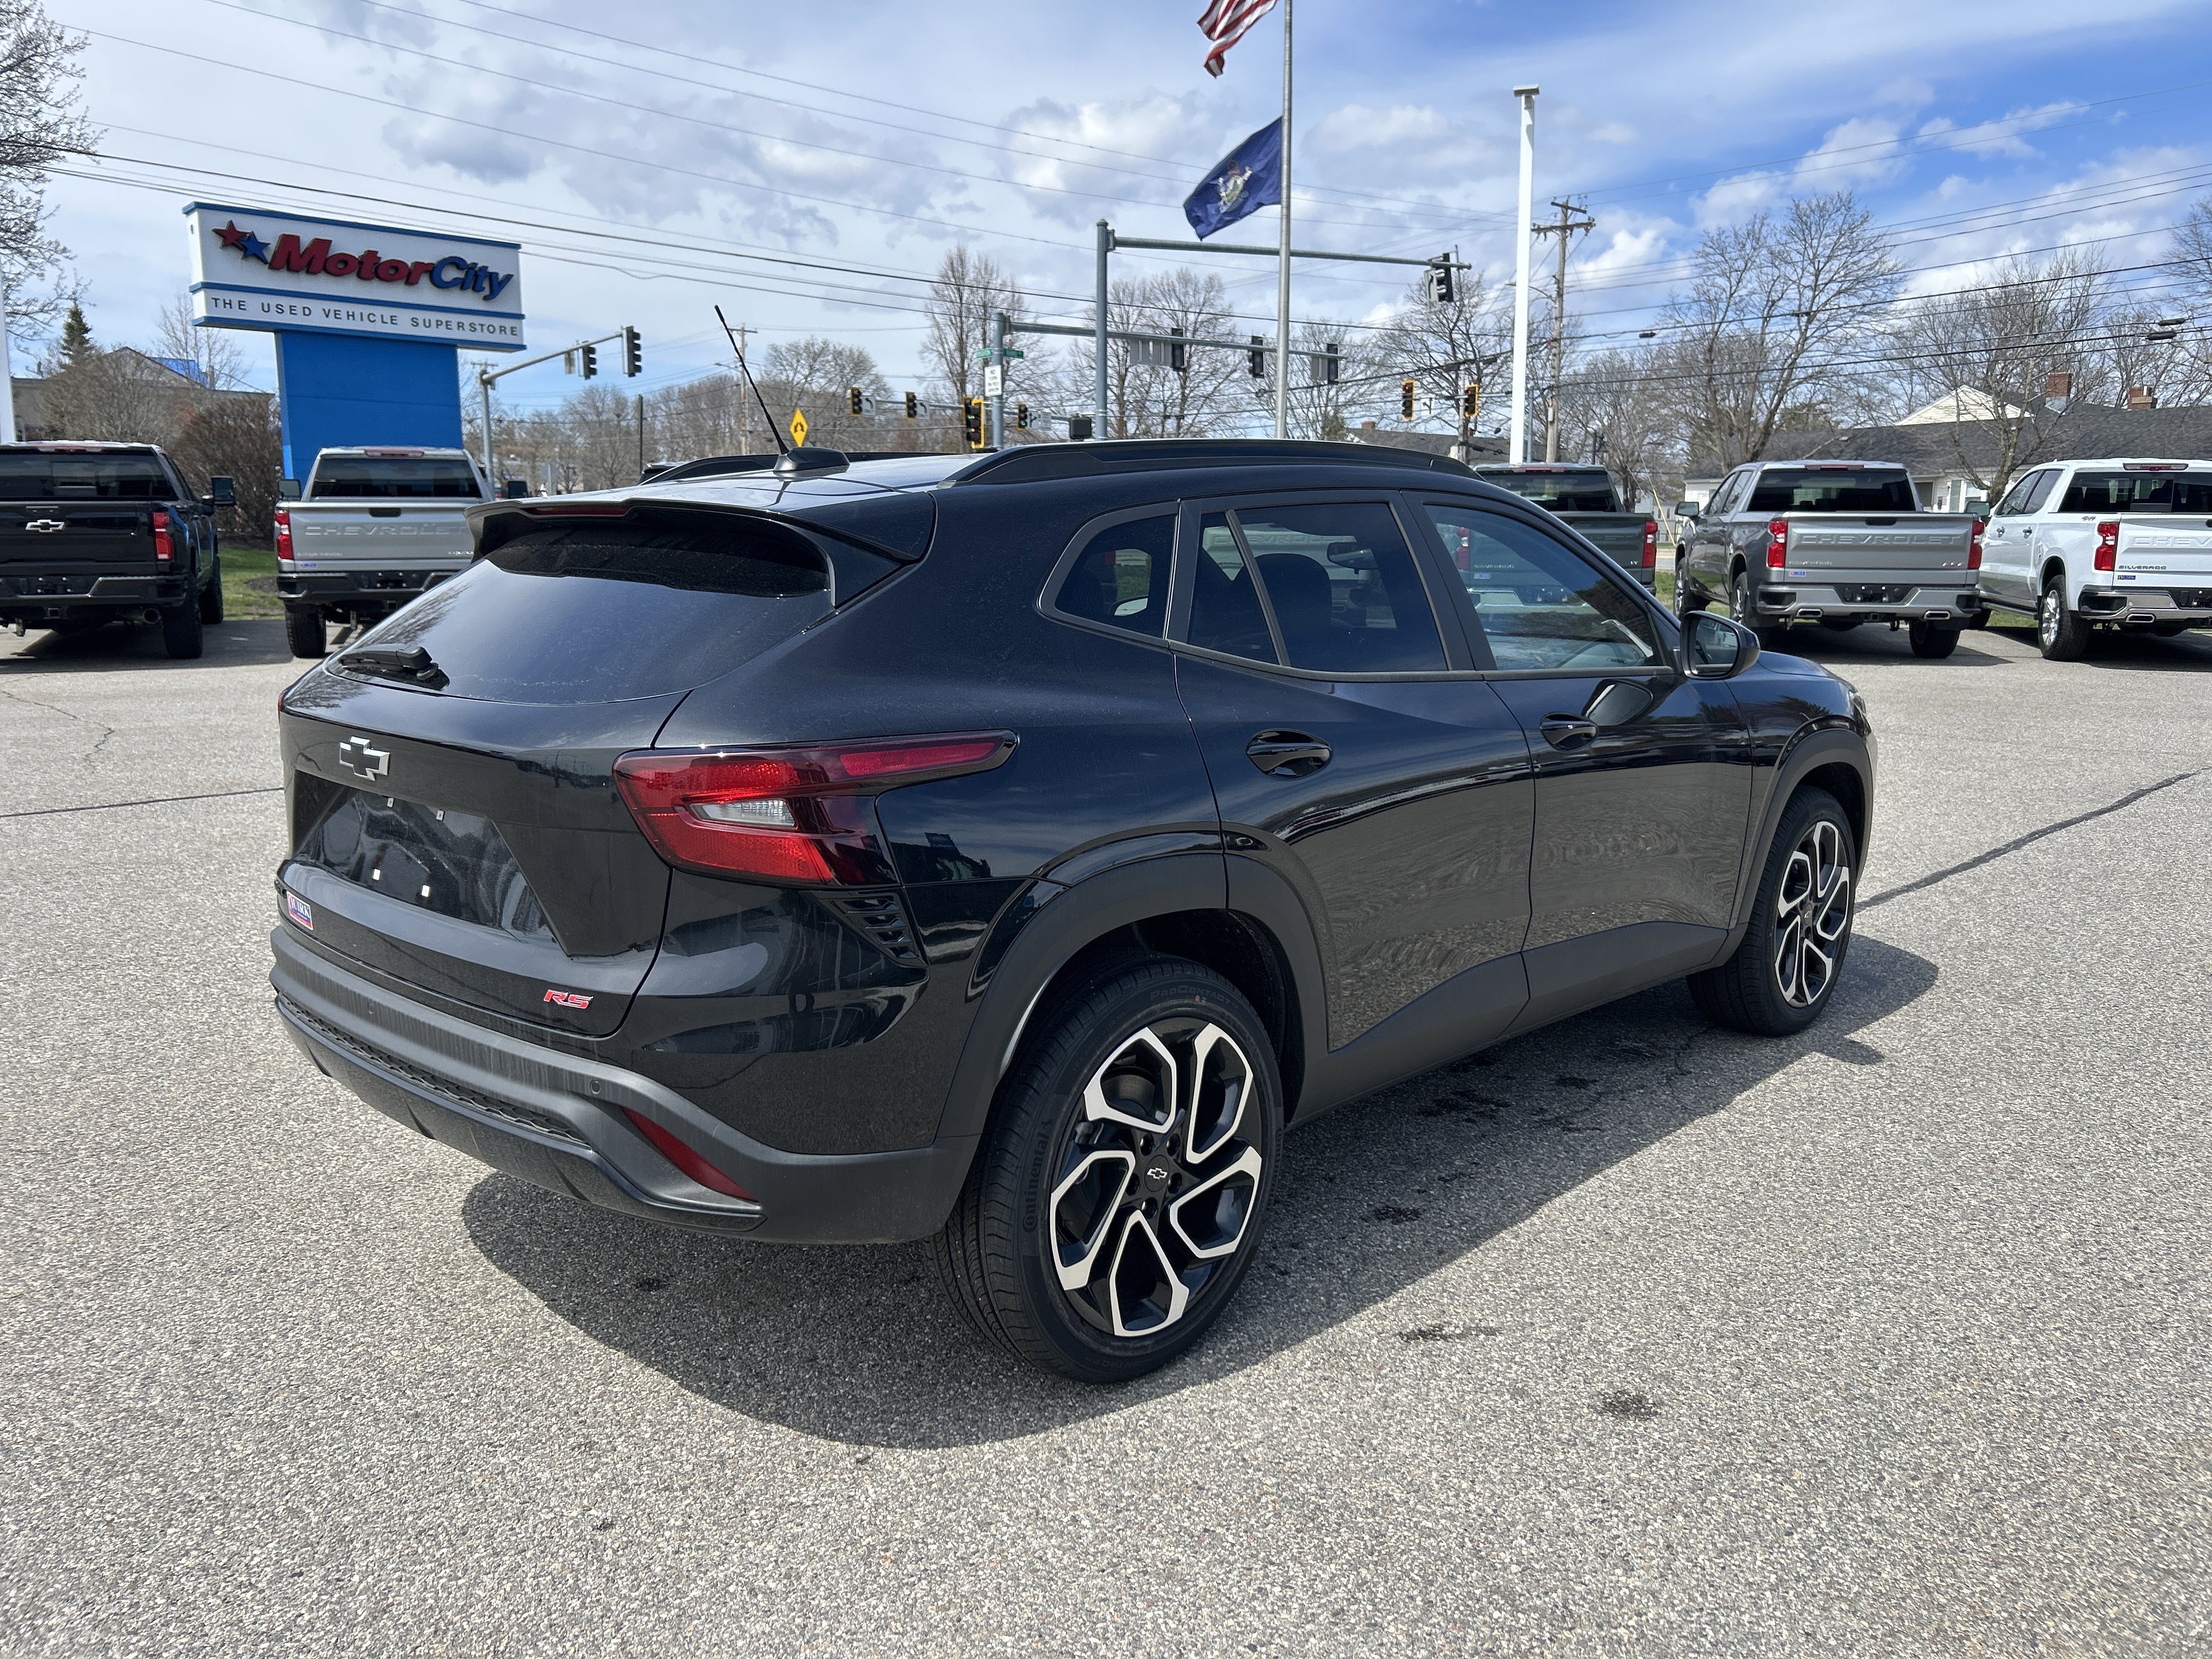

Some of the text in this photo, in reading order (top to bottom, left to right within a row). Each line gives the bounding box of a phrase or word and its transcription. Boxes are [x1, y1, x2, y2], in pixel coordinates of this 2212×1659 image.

[268, 233, 515, 301] MotorCity
[212, 297, 518, 336] THE USED VEHICLE SUPERSTORE
[1801, 535, 1961, 545] CHEVROLET
[288, 894, 311, 918] QUIRK
[543, 989, 594, 1009] RS
